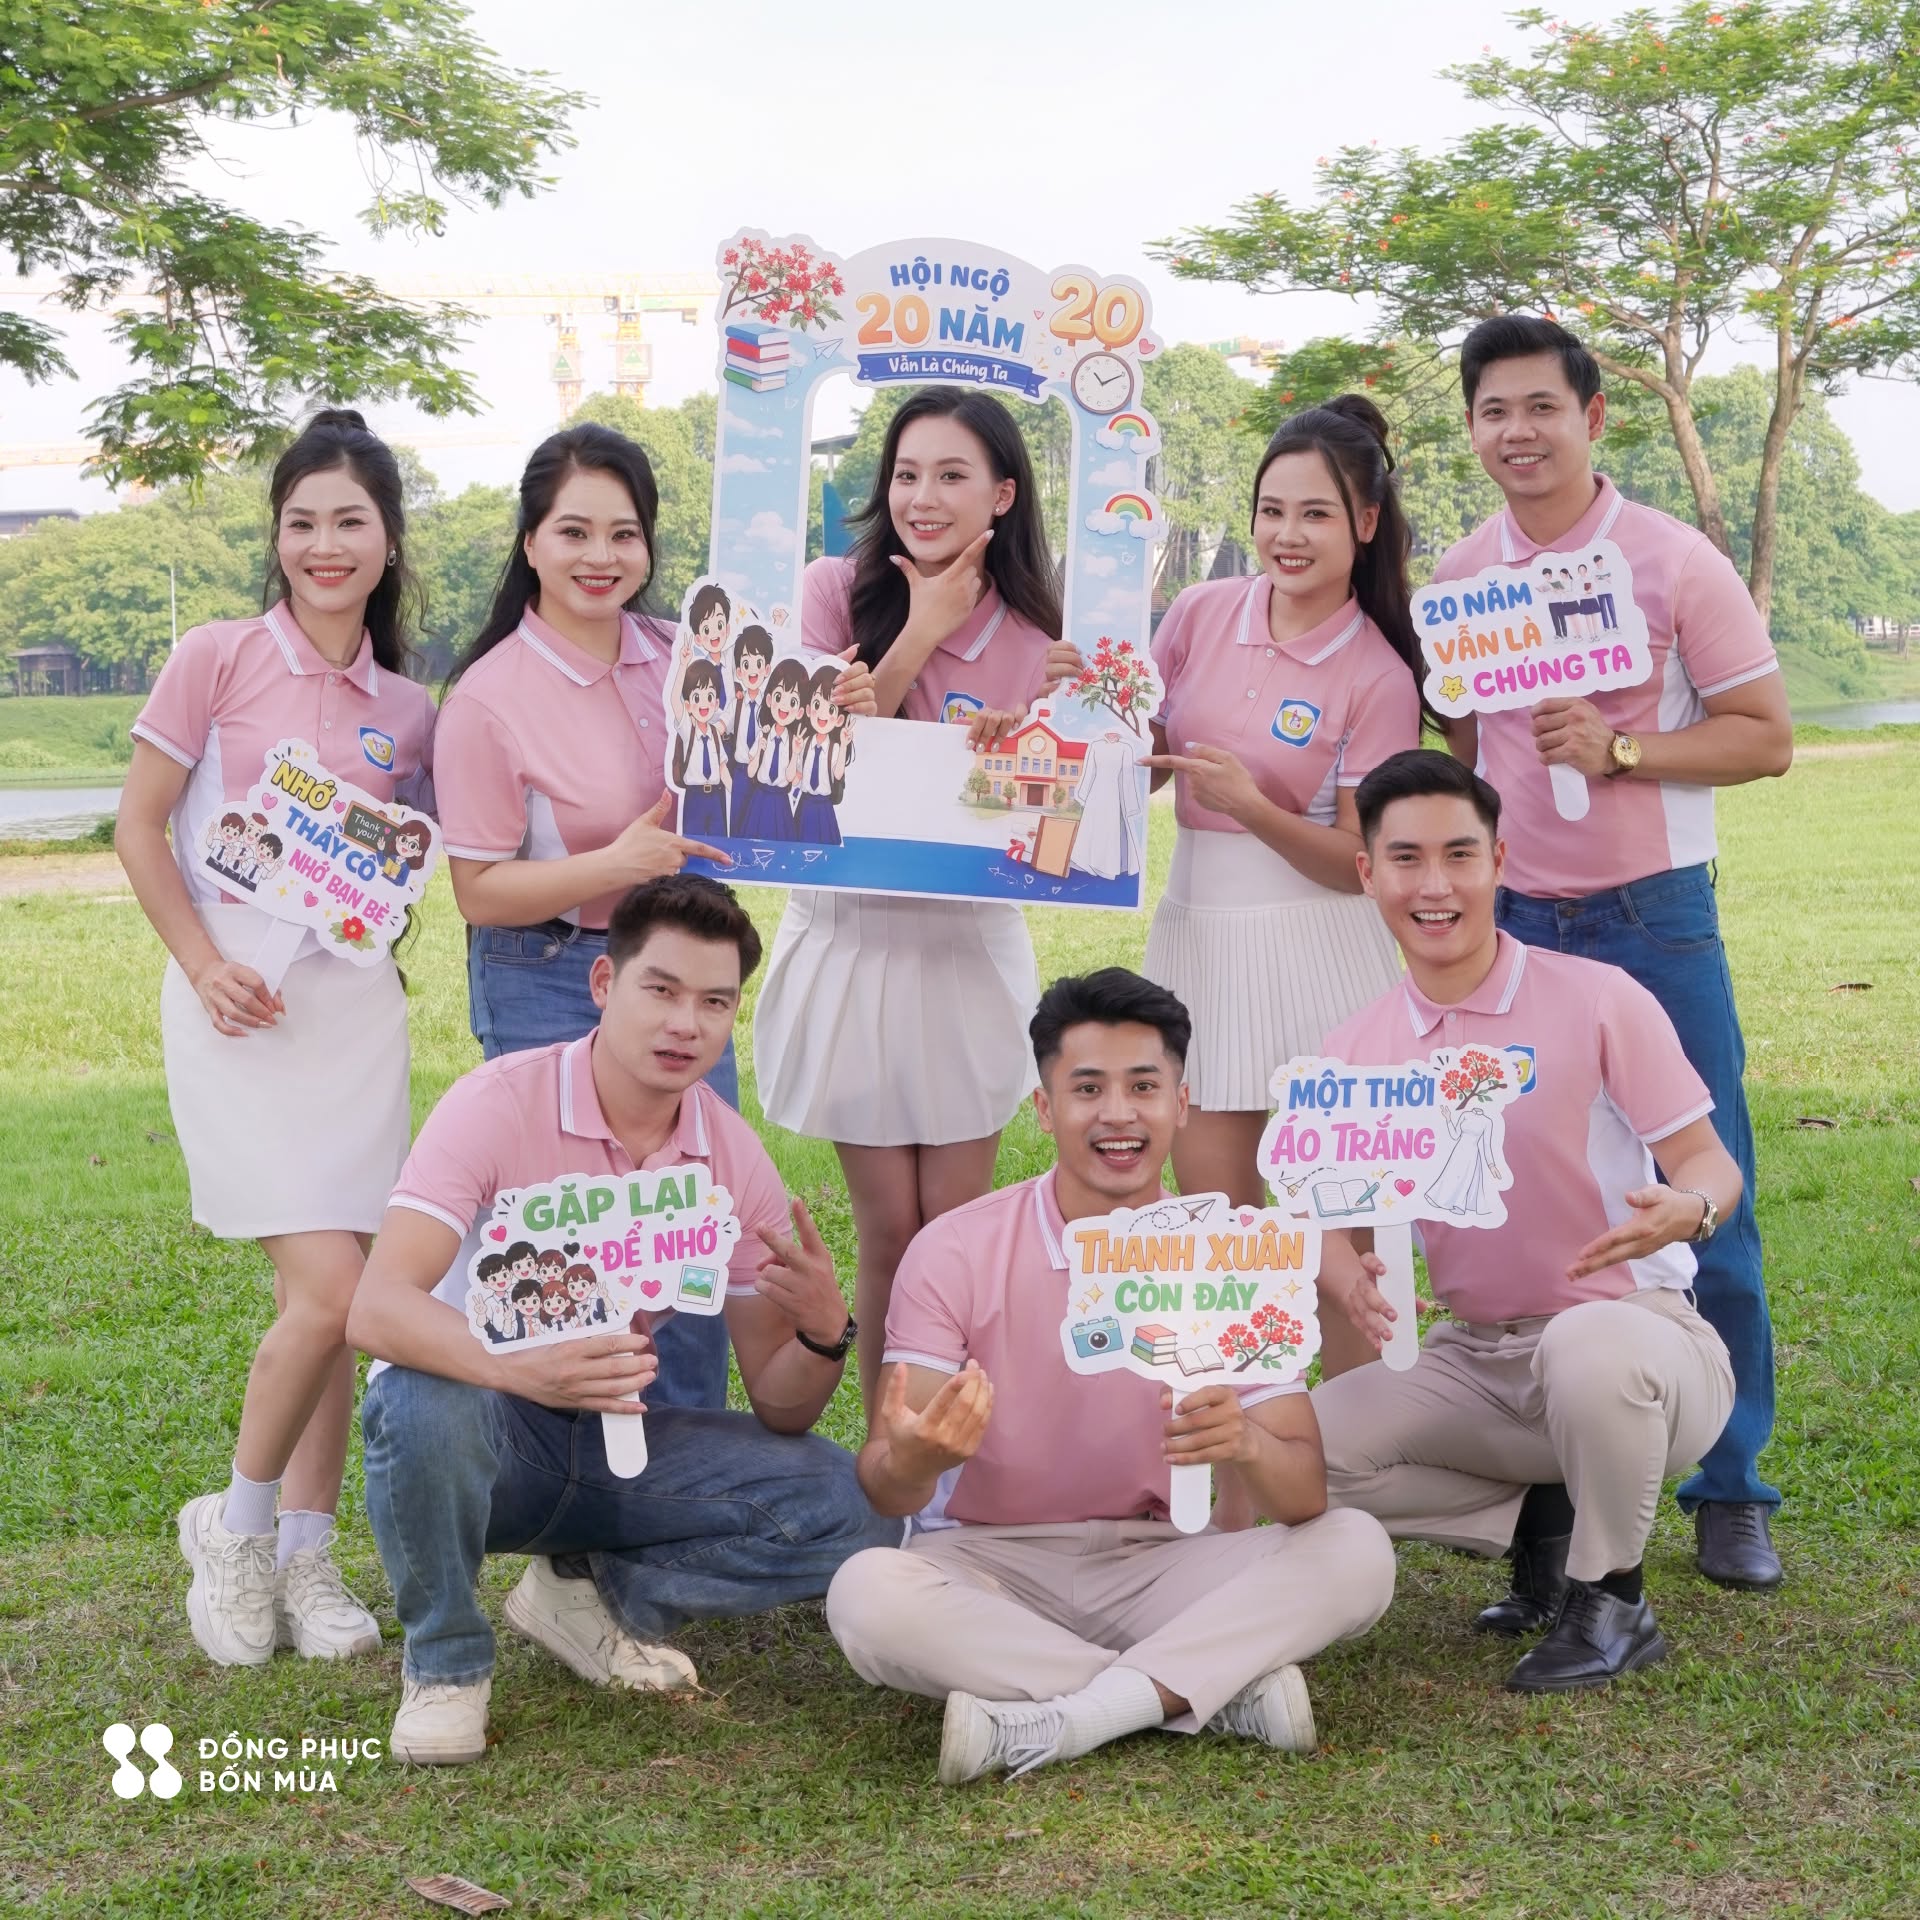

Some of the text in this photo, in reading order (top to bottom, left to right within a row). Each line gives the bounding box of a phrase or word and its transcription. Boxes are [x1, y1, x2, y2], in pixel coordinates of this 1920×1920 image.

[890, 256, 1011, 302] HỘI NGỘ
[855, 292, 1025, 354] 20 NĂM
[1049, 273, 1144, 350] 20
[888, 355, 1008, 382] Vẫn Là Chúng Ta
[1422, 580, 1533, 626] 20 NĂM
[1433, 616, 1542, 665] VẪN LÀ
[1473, 644, 1633, 698] CHÚNG TA
[271, 760, 337, 811] NHỚ
[285, 805, 377, 882] THẦY CÔ
[354, 813, 381, 832] Thank
[355, 828, 377, 840] you!
[288, 848, 390, 927] NHỚ BẠN BÈ
[1288, 1068, 1435, 1117] MỘT THỜI
[1270, 1113, 1436, 1165] ÁO TRẮNG
[522, 1173, 697, 1237] GẶP LẠI
[600, 1215, 719, 1272] ĐỂ NHỚ
[1074, 1219, 1304, 1274] THANH XUÂN
[1114, 1274, 1259, 1314] CÒN ĐÂY
